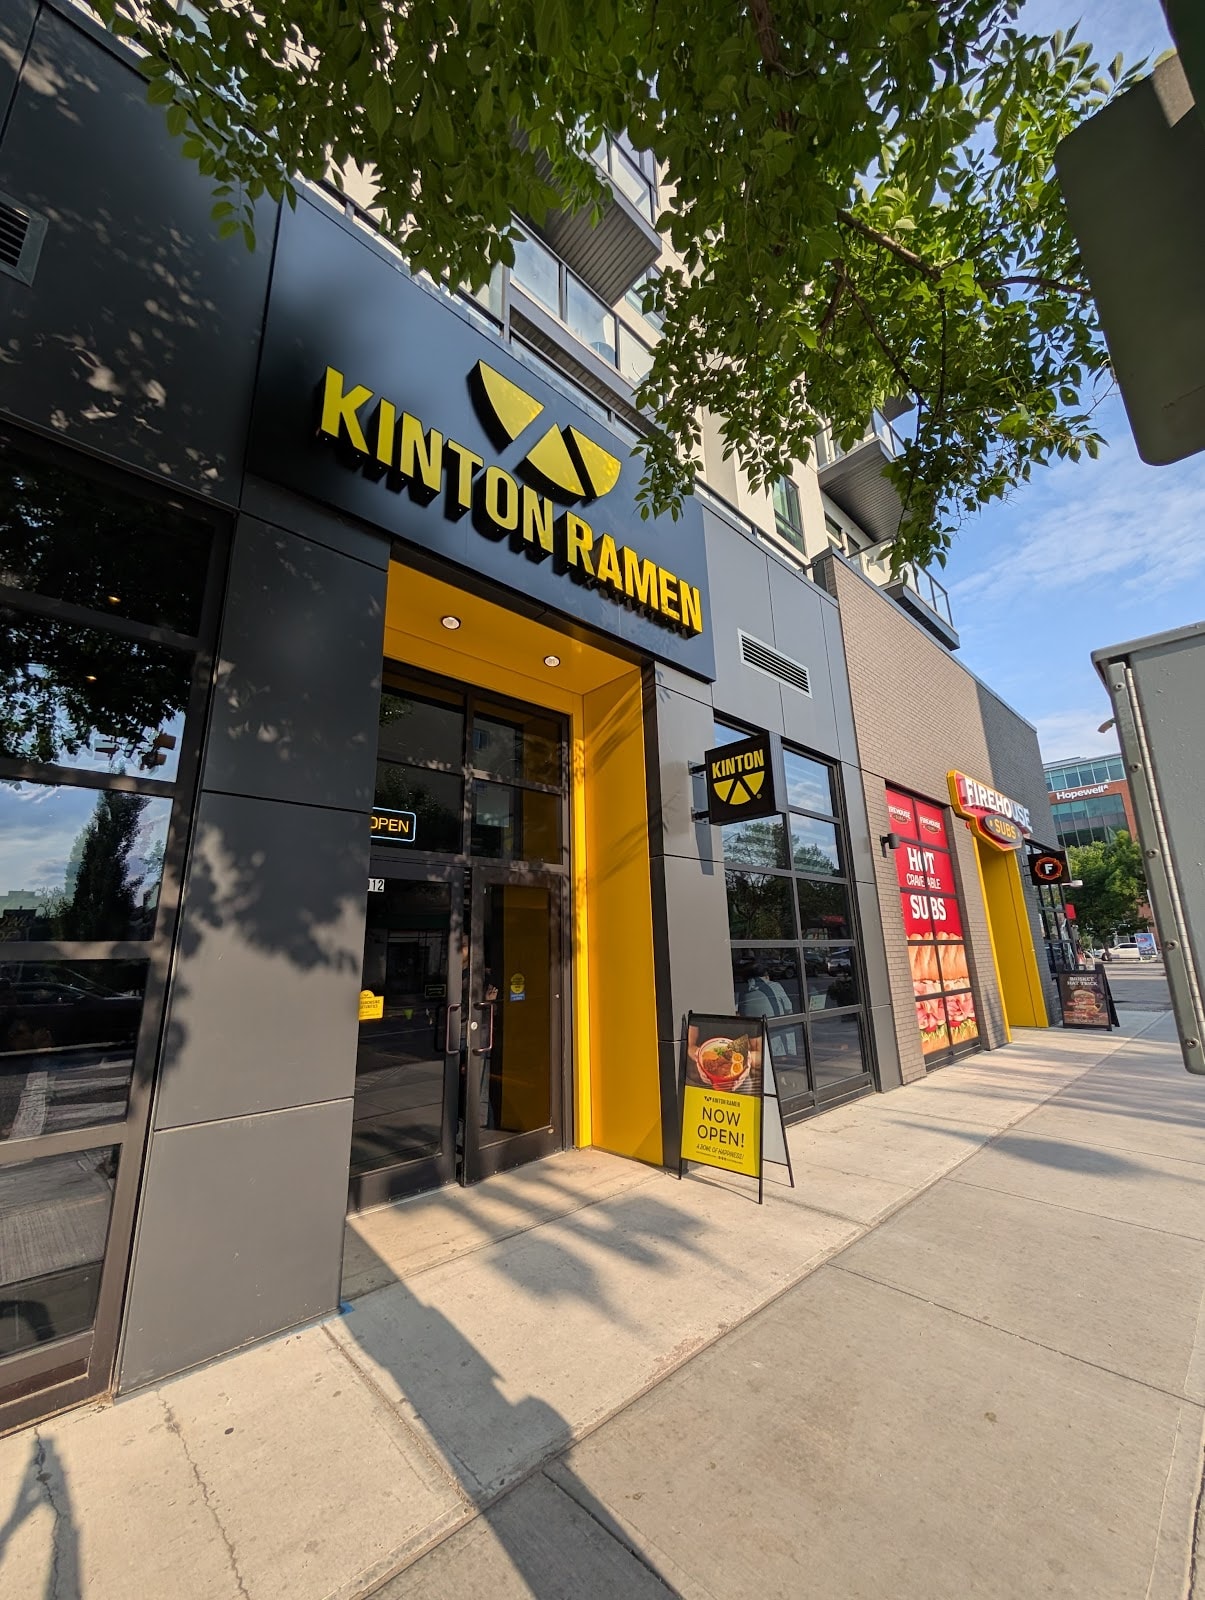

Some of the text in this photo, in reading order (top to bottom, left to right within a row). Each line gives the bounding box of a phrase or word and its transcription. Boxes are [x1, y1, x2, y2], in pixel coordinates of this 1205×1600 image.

[319, 365, 703, 633] KINTON RAMEN
[711, 749, 765, 780] KINTON
[964, 776, 1033, 833] FIREHOUSE
[1056, 785, 1104, 800] Hopewell
[994, 818, 1017, 840] SUBS
[906, 847, 935, 875] HOT
[1044, 863, 1054, 875] F
[368, 879, 384, 891] 12
[910, 894, 947, 921] SUBS
[702, 1106, 741, 1127] NOW
[697, 1124, 745, 1148] OPEN!
